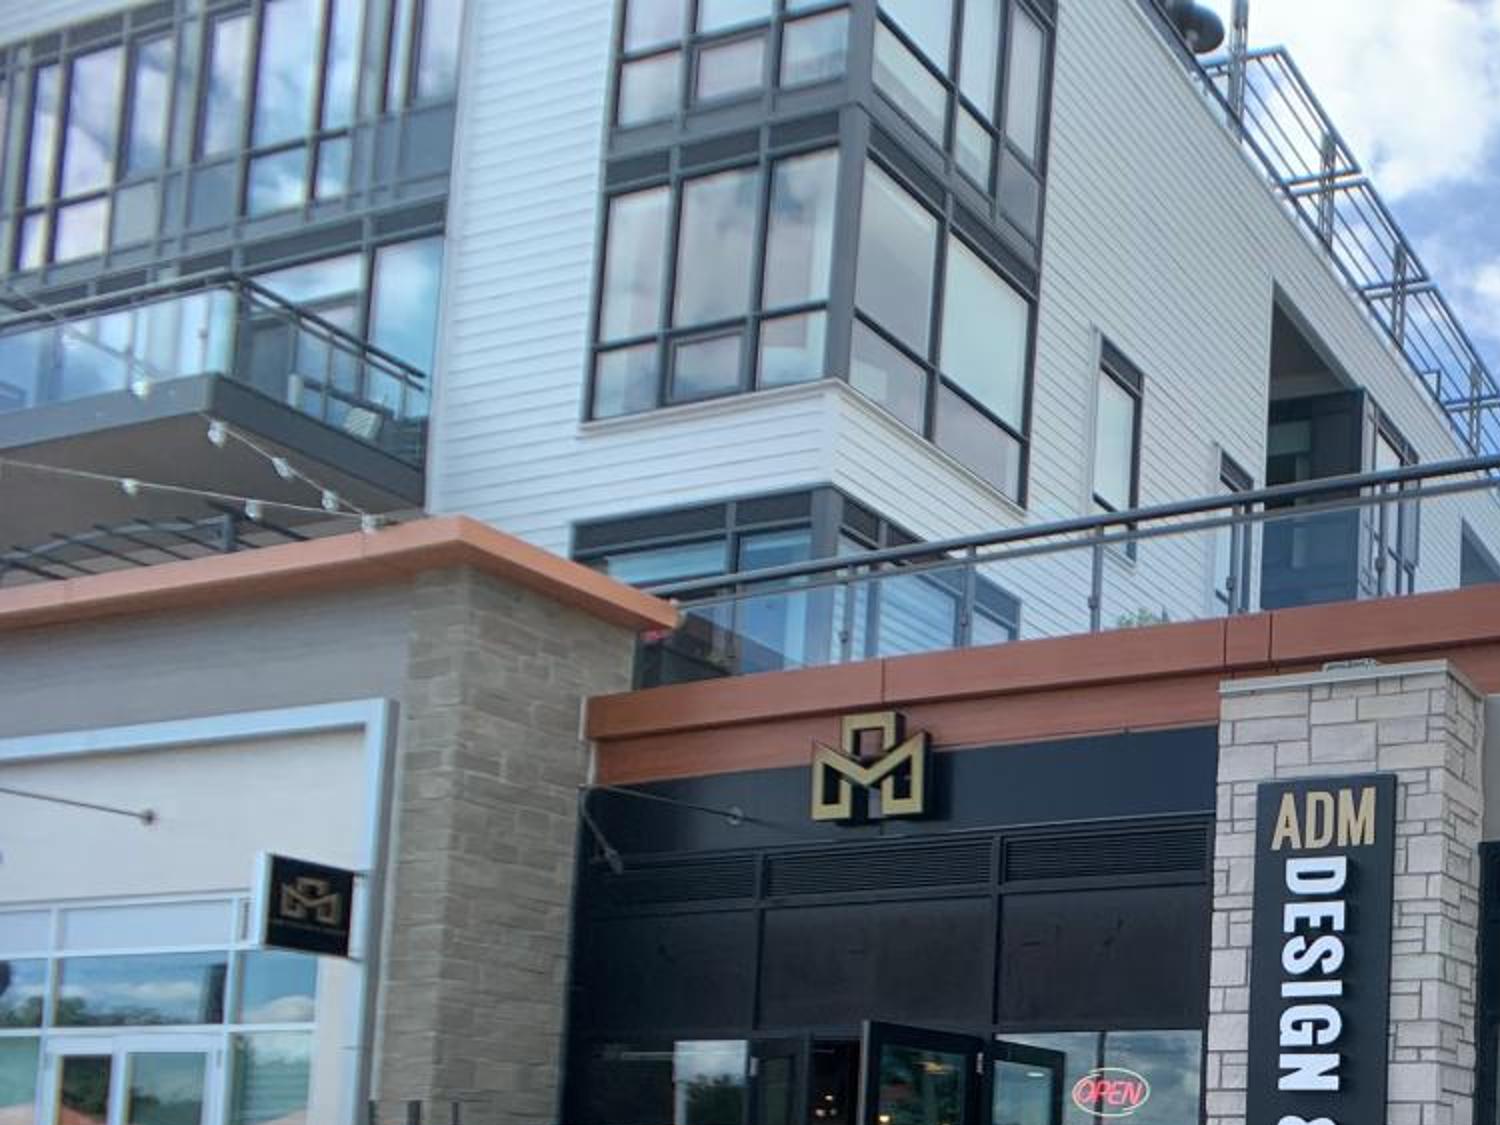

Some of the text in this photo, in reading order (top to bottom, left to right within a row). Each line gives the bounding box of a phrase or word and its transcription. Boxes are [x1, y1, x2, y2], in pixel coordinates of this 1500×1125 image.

[1271, 786, 1377, 850] ADM
[1278, 855, 1348, 1091] DESIGN
[1077, 1079, 1143, 1105] OPEN
